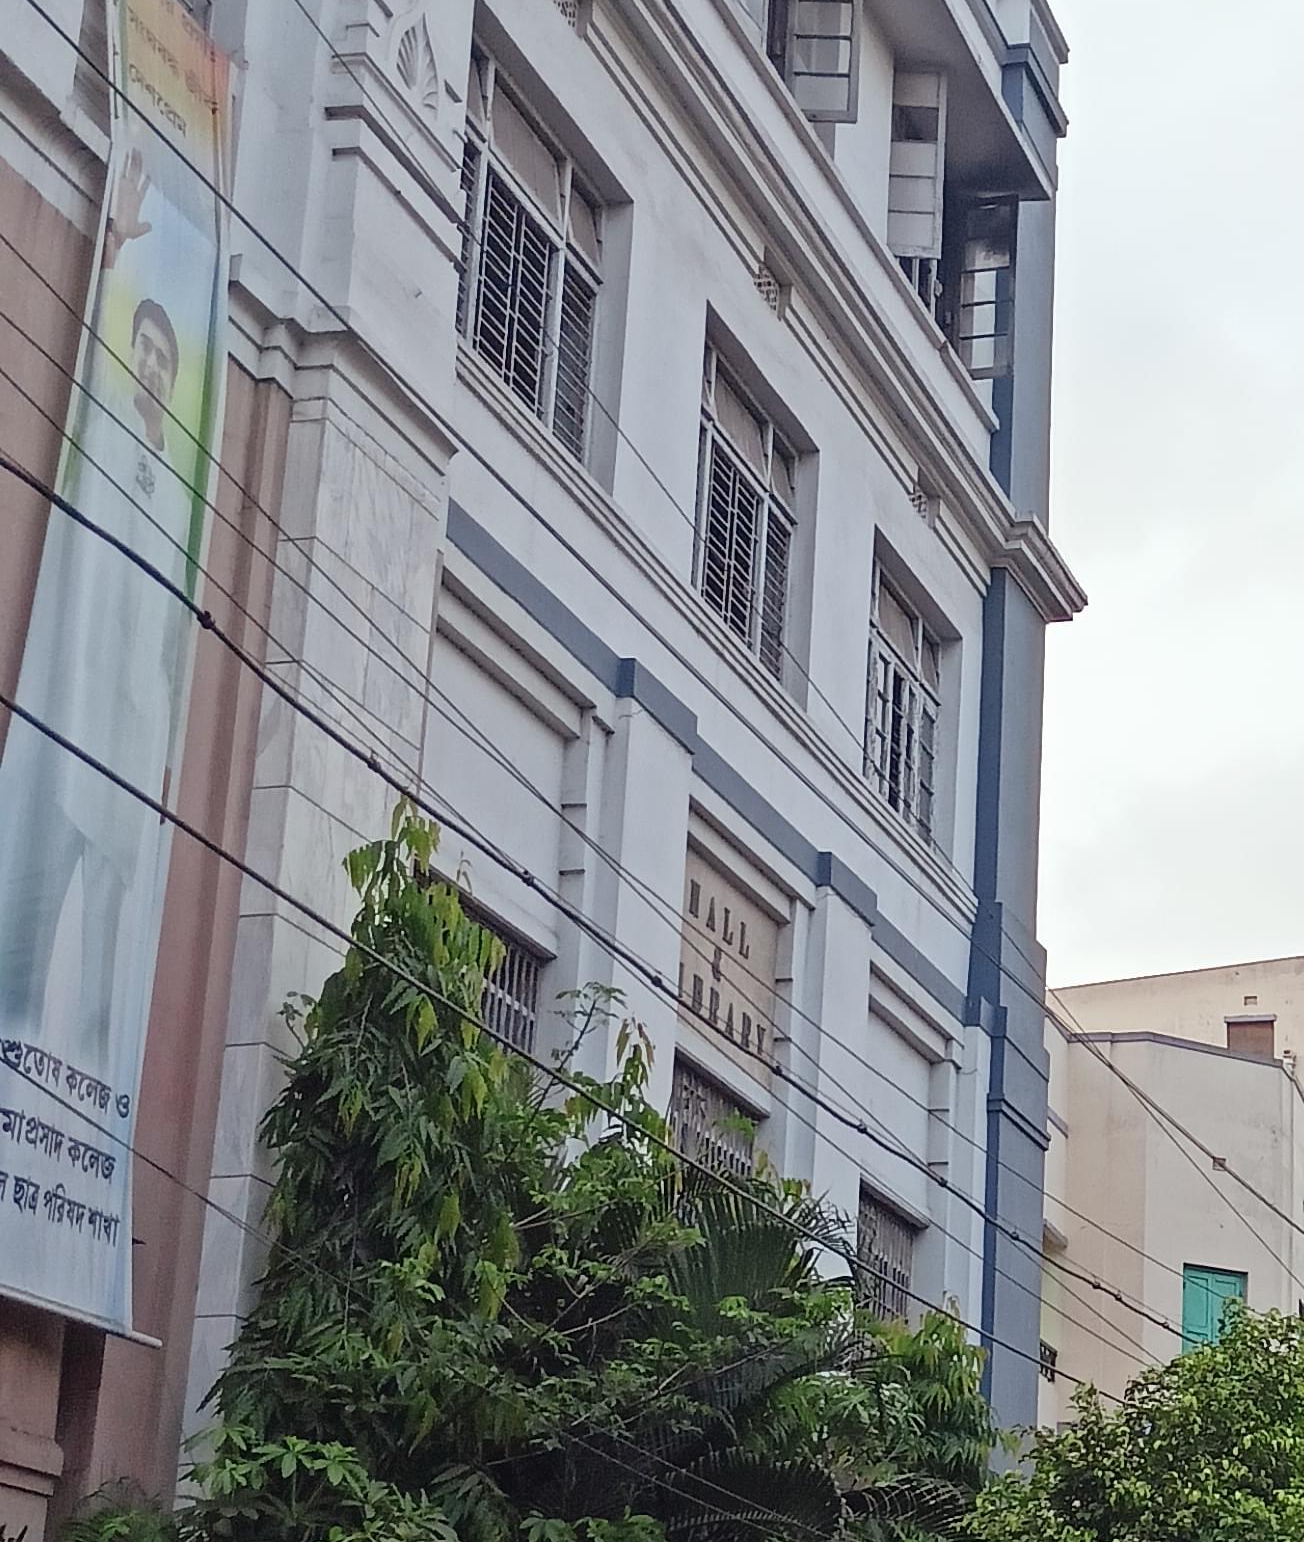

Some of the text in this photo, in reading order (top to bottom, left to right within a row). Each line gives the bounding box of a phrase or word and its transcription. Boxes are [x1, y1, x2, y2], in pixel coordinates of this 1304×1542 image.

[689, 879, 750, 960] HALL
[678, 962, 767, 1055] IBRARY
[66, 1064, 112, 1115] কলেজ
[67, 1137, 116, 1185] কলেজ
